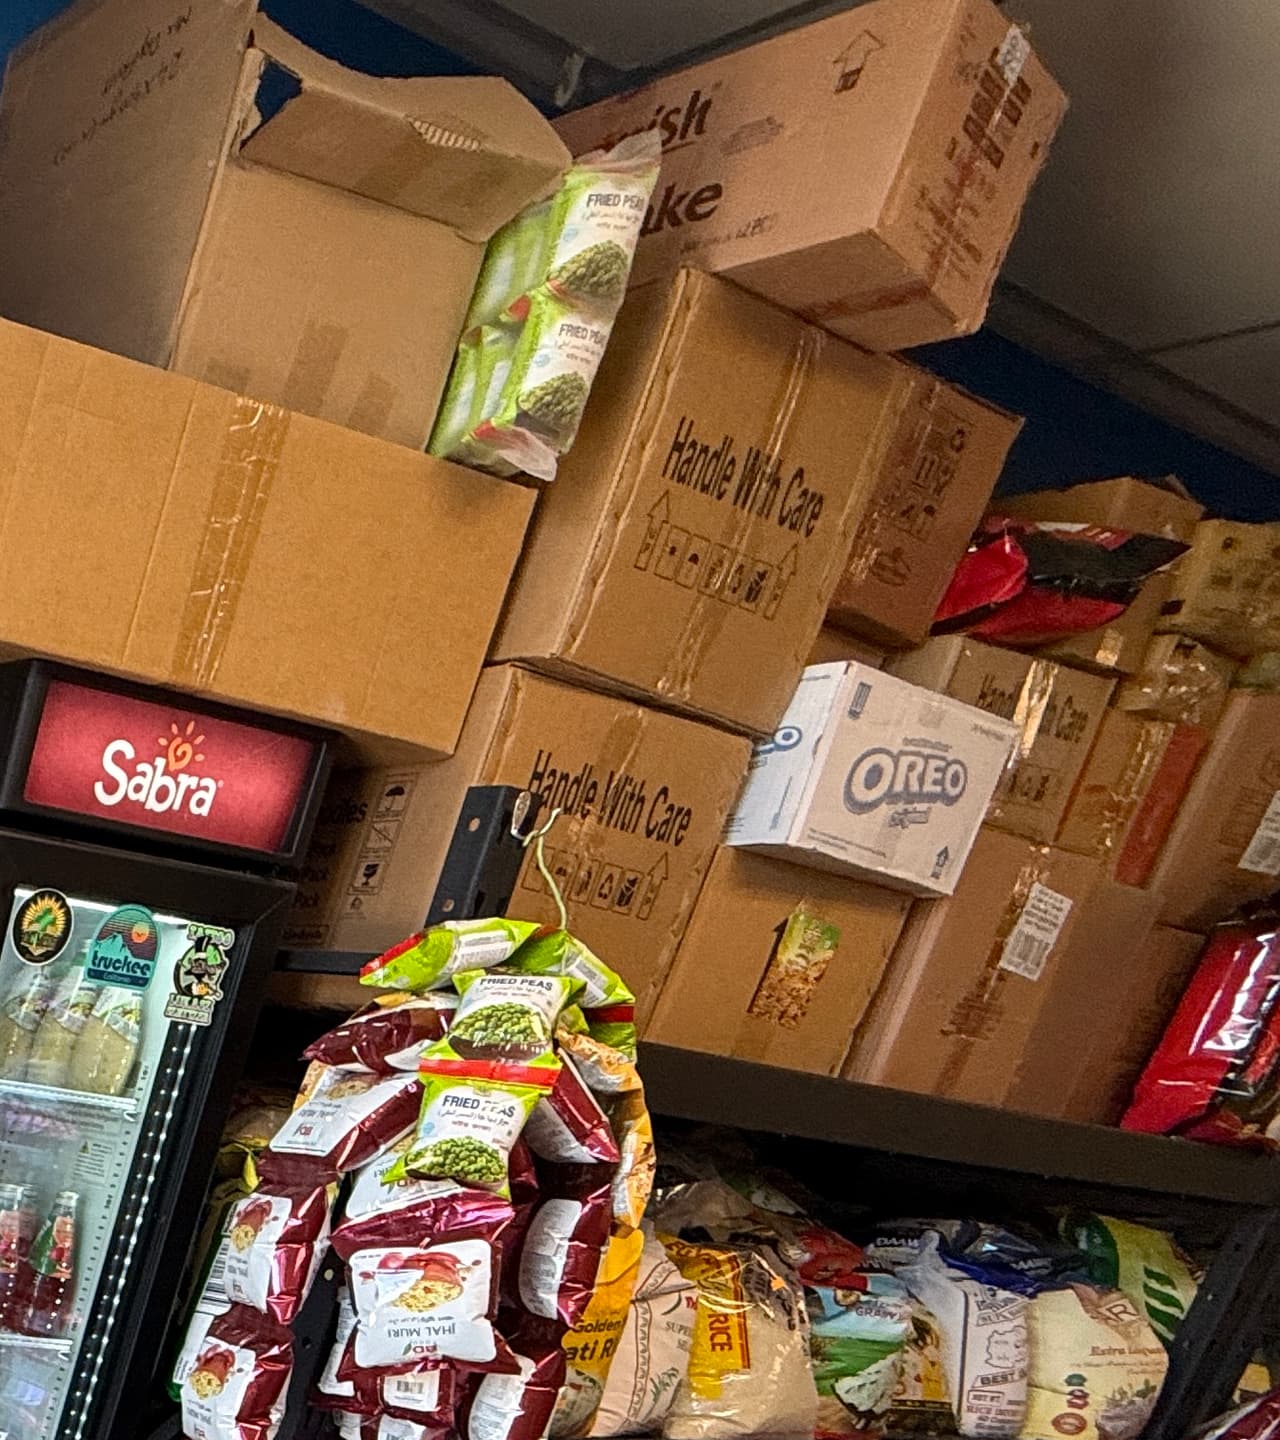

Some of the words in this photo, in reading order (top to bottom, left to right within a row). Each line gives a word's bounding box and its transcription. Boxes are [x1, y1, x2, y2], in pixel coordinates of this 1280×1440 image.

[587, 193, 621, 208] FRIED
[559, 323, 589, 340] FRIED
[661, 417, 736, 502] Handle
[741, 447, 782, 518] With
[777, 466, 825, 538] Care
[94, 738, 218, 817] Sabra
[844, 747, 968, 814] OREO
[527, 748, 597, 821] Handle
[598, 777, 647, 831] With
[645, 796, 693, 847] Care
[91, 950, 152, 976] truckee
[480, 976, 518, 988] FRIED
[521, 977, 553, 992] PEAS
[442, 1094, 480, 1110] FRIED
[386, 1324, 423, 1340] MURI
[426, 1322, 457, 1337] JHAL
[572, 1317, 624, 1334] Golden
